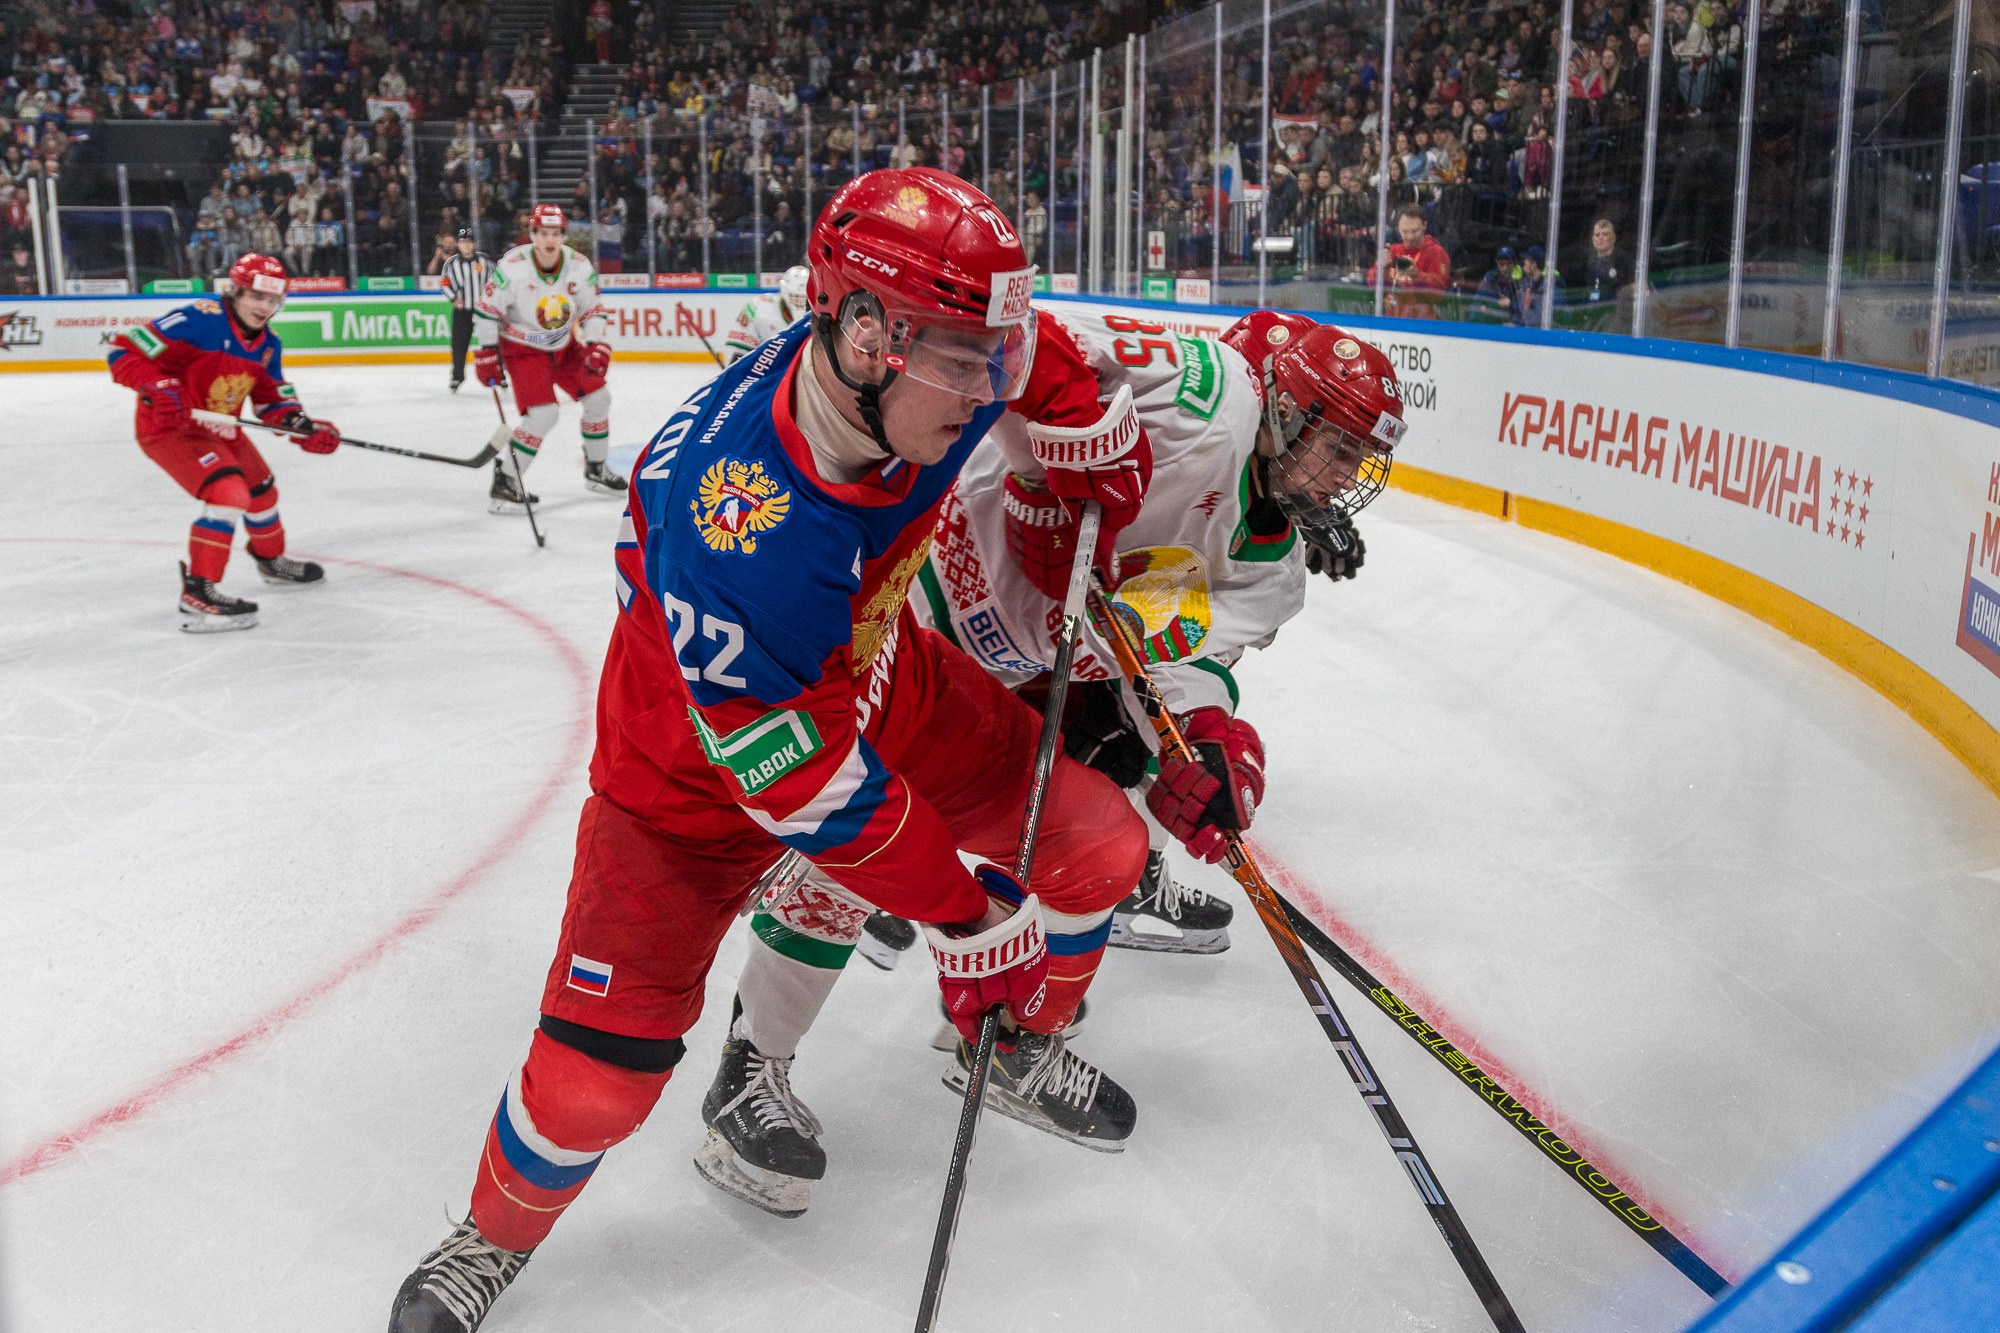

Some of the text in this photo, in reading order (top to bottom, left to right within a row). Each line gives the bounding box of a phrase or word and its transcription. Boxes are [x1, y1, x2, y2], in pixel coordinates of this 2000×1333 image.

[977, 209, 1015, 244] 22
[846, 248, 898, 277] CCM
[405, 309, 450, 339] СТА
[603, 307, 716, 337] FHR.RU
[1103, 314, 1178, 369] 85
[751, 338, 787, 377] ЧТОБЫ
[1376, 341, 1431, 372] СТВО
[640, 387, 712, 480] YOV
[1498, 391, 1822, 534] КРАСНАЯ МАШИНА
[1101, 483, 1127, 502] COVERT
[664, 591, 747, 689] 22
[737, 742, 801, 792] ТАВОК
[928, 918, 1040, 973] RRIOR
[1307, 978, 1446, 1206] TRUE
[1371, 986, 1662, 1231] SHERWOOD
